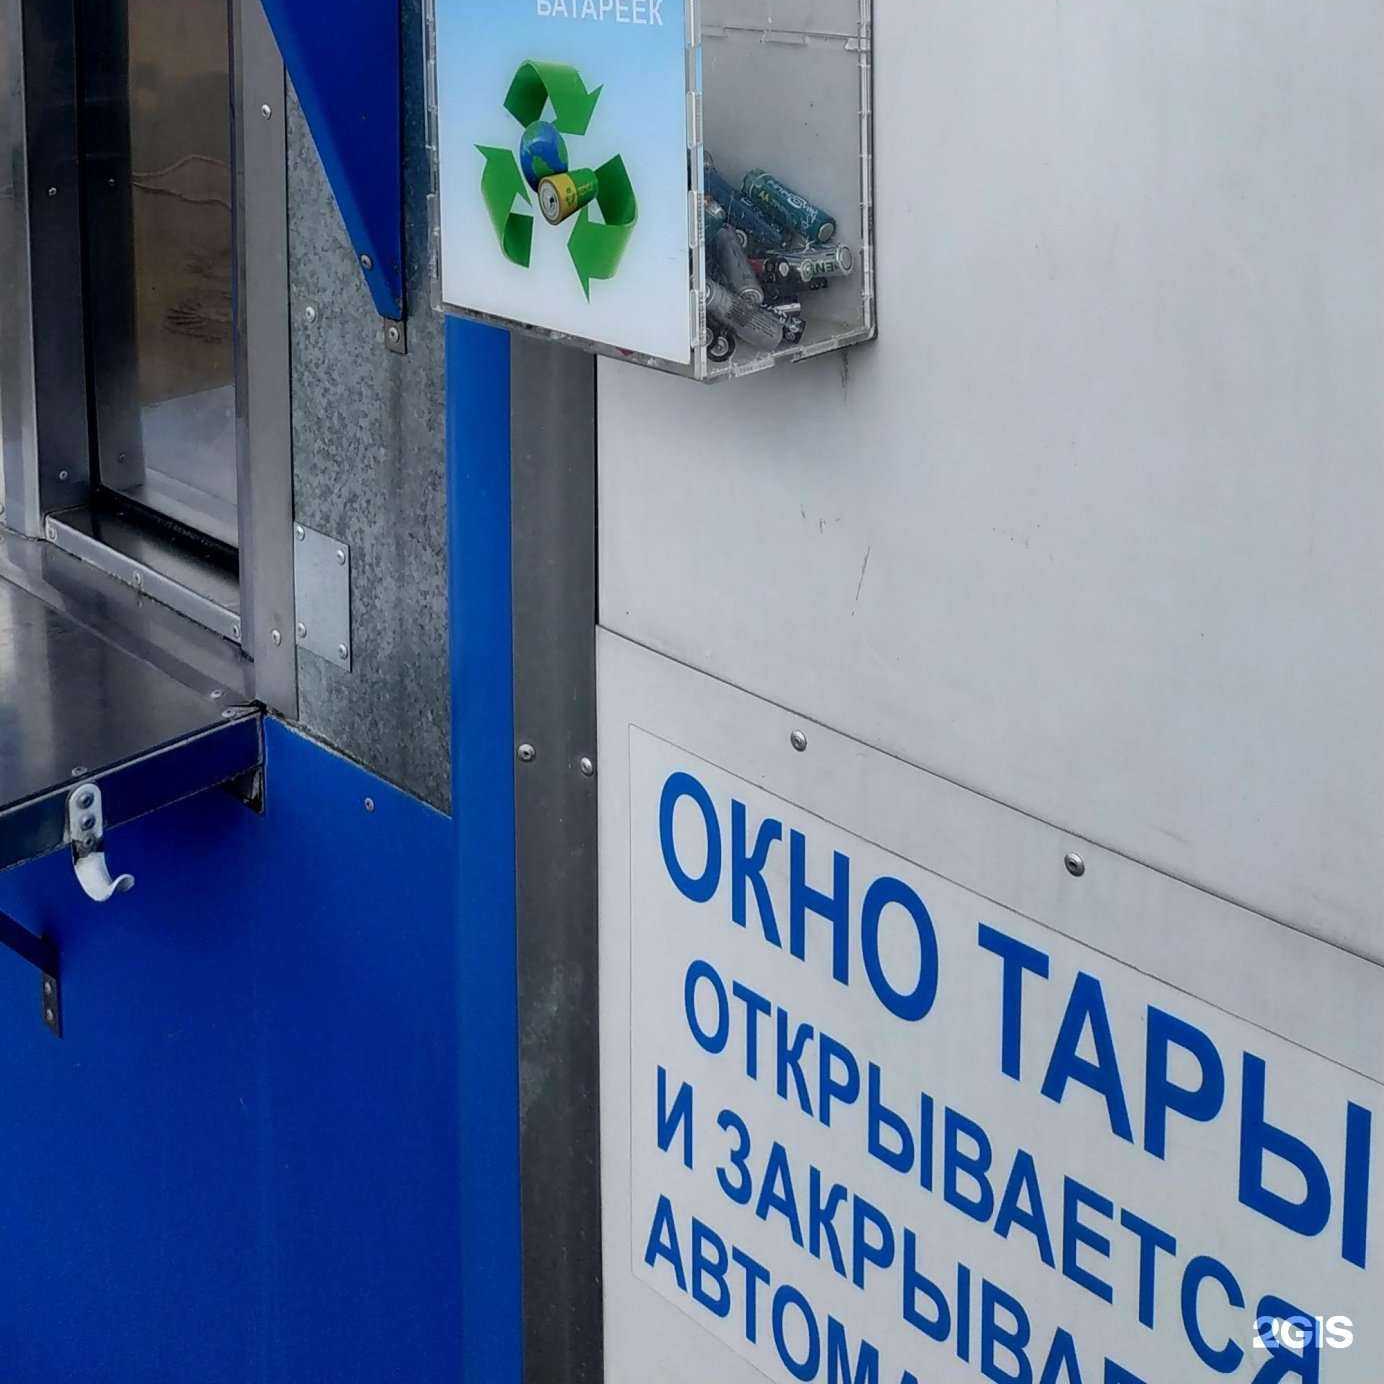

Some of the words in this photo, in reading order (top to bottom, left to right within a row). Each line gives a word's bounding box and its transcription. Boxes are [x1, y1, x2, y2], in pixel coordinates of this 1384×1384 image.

[656, 1065, 694, 1170] И
[659, 771, 939, 1022] ОКНО
[978, 921, 1372, 1270] ТАРЫ
[684, 959, 1320, 1384] ОТКРЫВАЕТСЯ
[644, 1193, 920, 1384] АВТОМ
